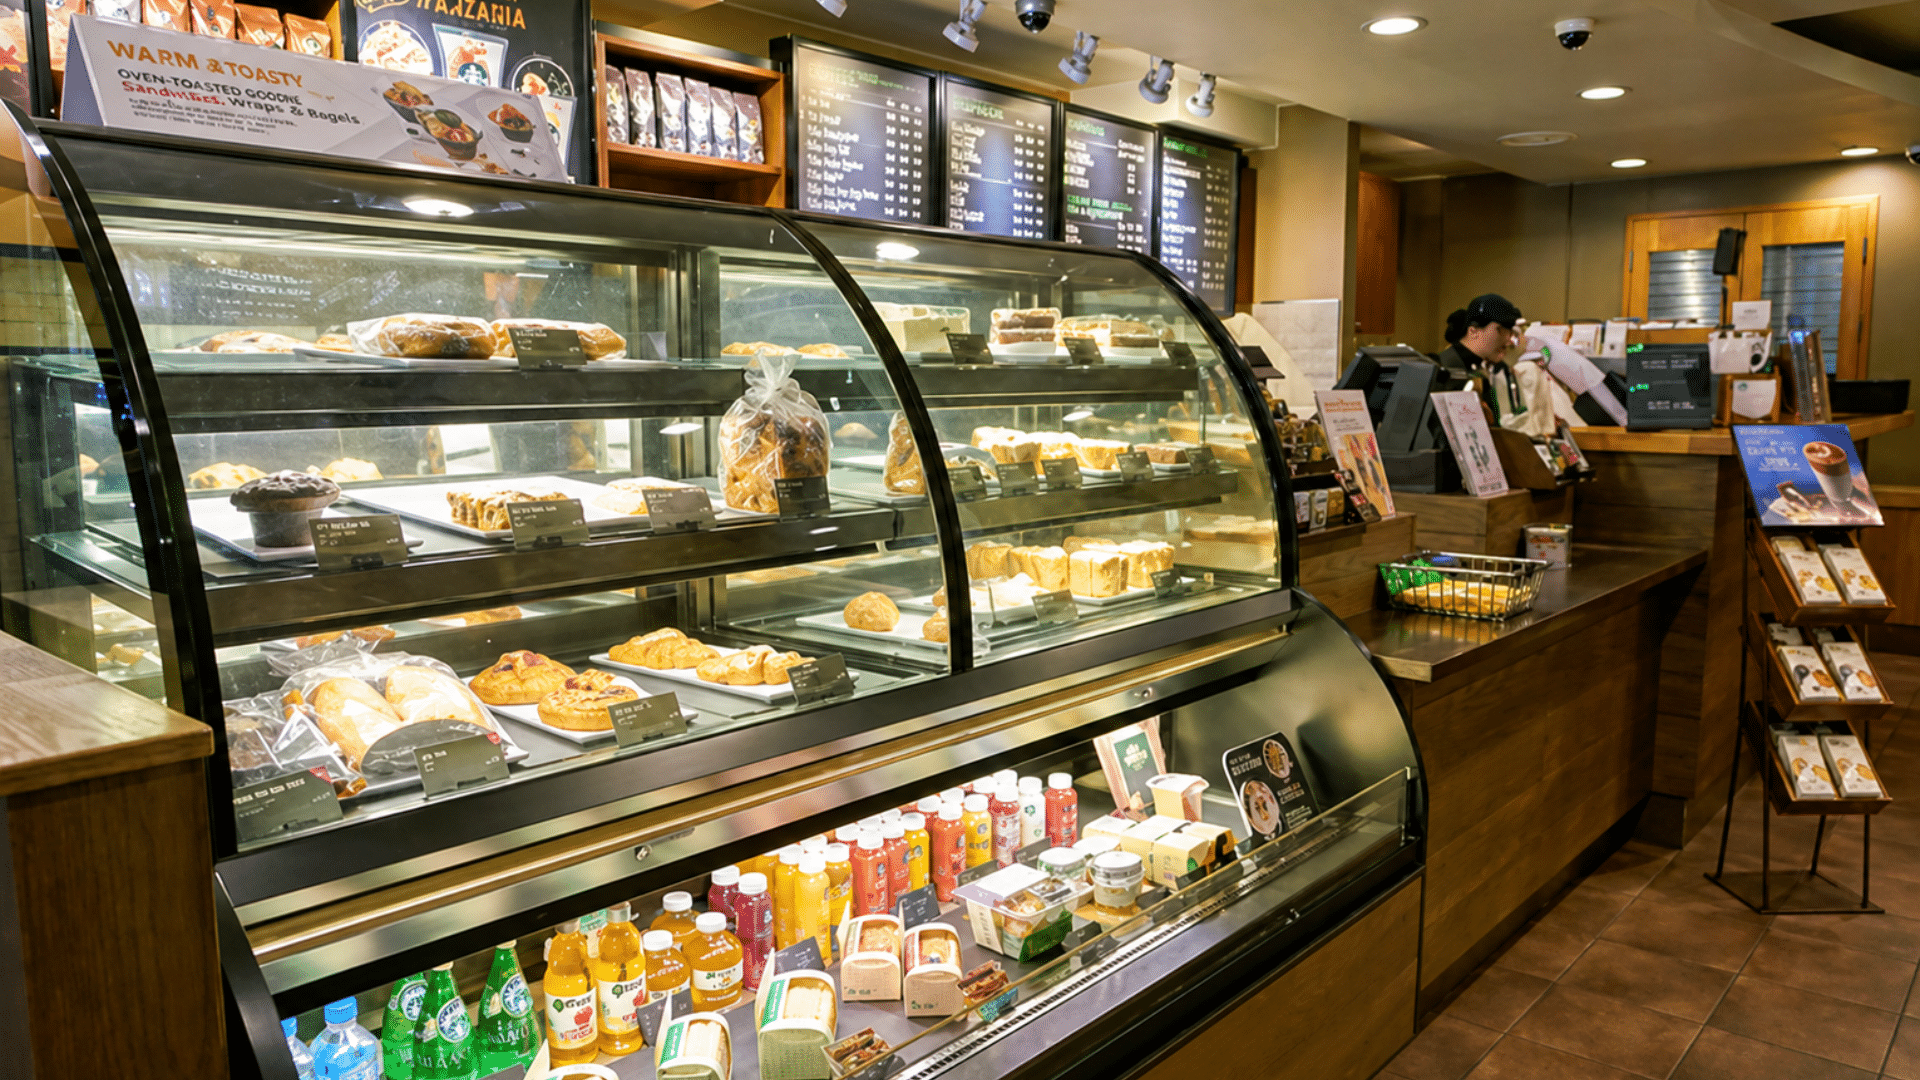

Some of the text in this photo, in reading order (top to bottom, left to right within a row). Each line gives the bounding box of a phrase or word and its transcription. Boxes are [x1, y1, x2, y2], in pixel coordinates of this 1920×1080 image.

[107, 40, 199, 70] WARM
[224, 61, 303, 87] TOASTY
[117, 68, 241, 96] OVEN-TOASTED
[228, 97, 285, 114] Wraps
[307, 108, 360, 125] Bagels
